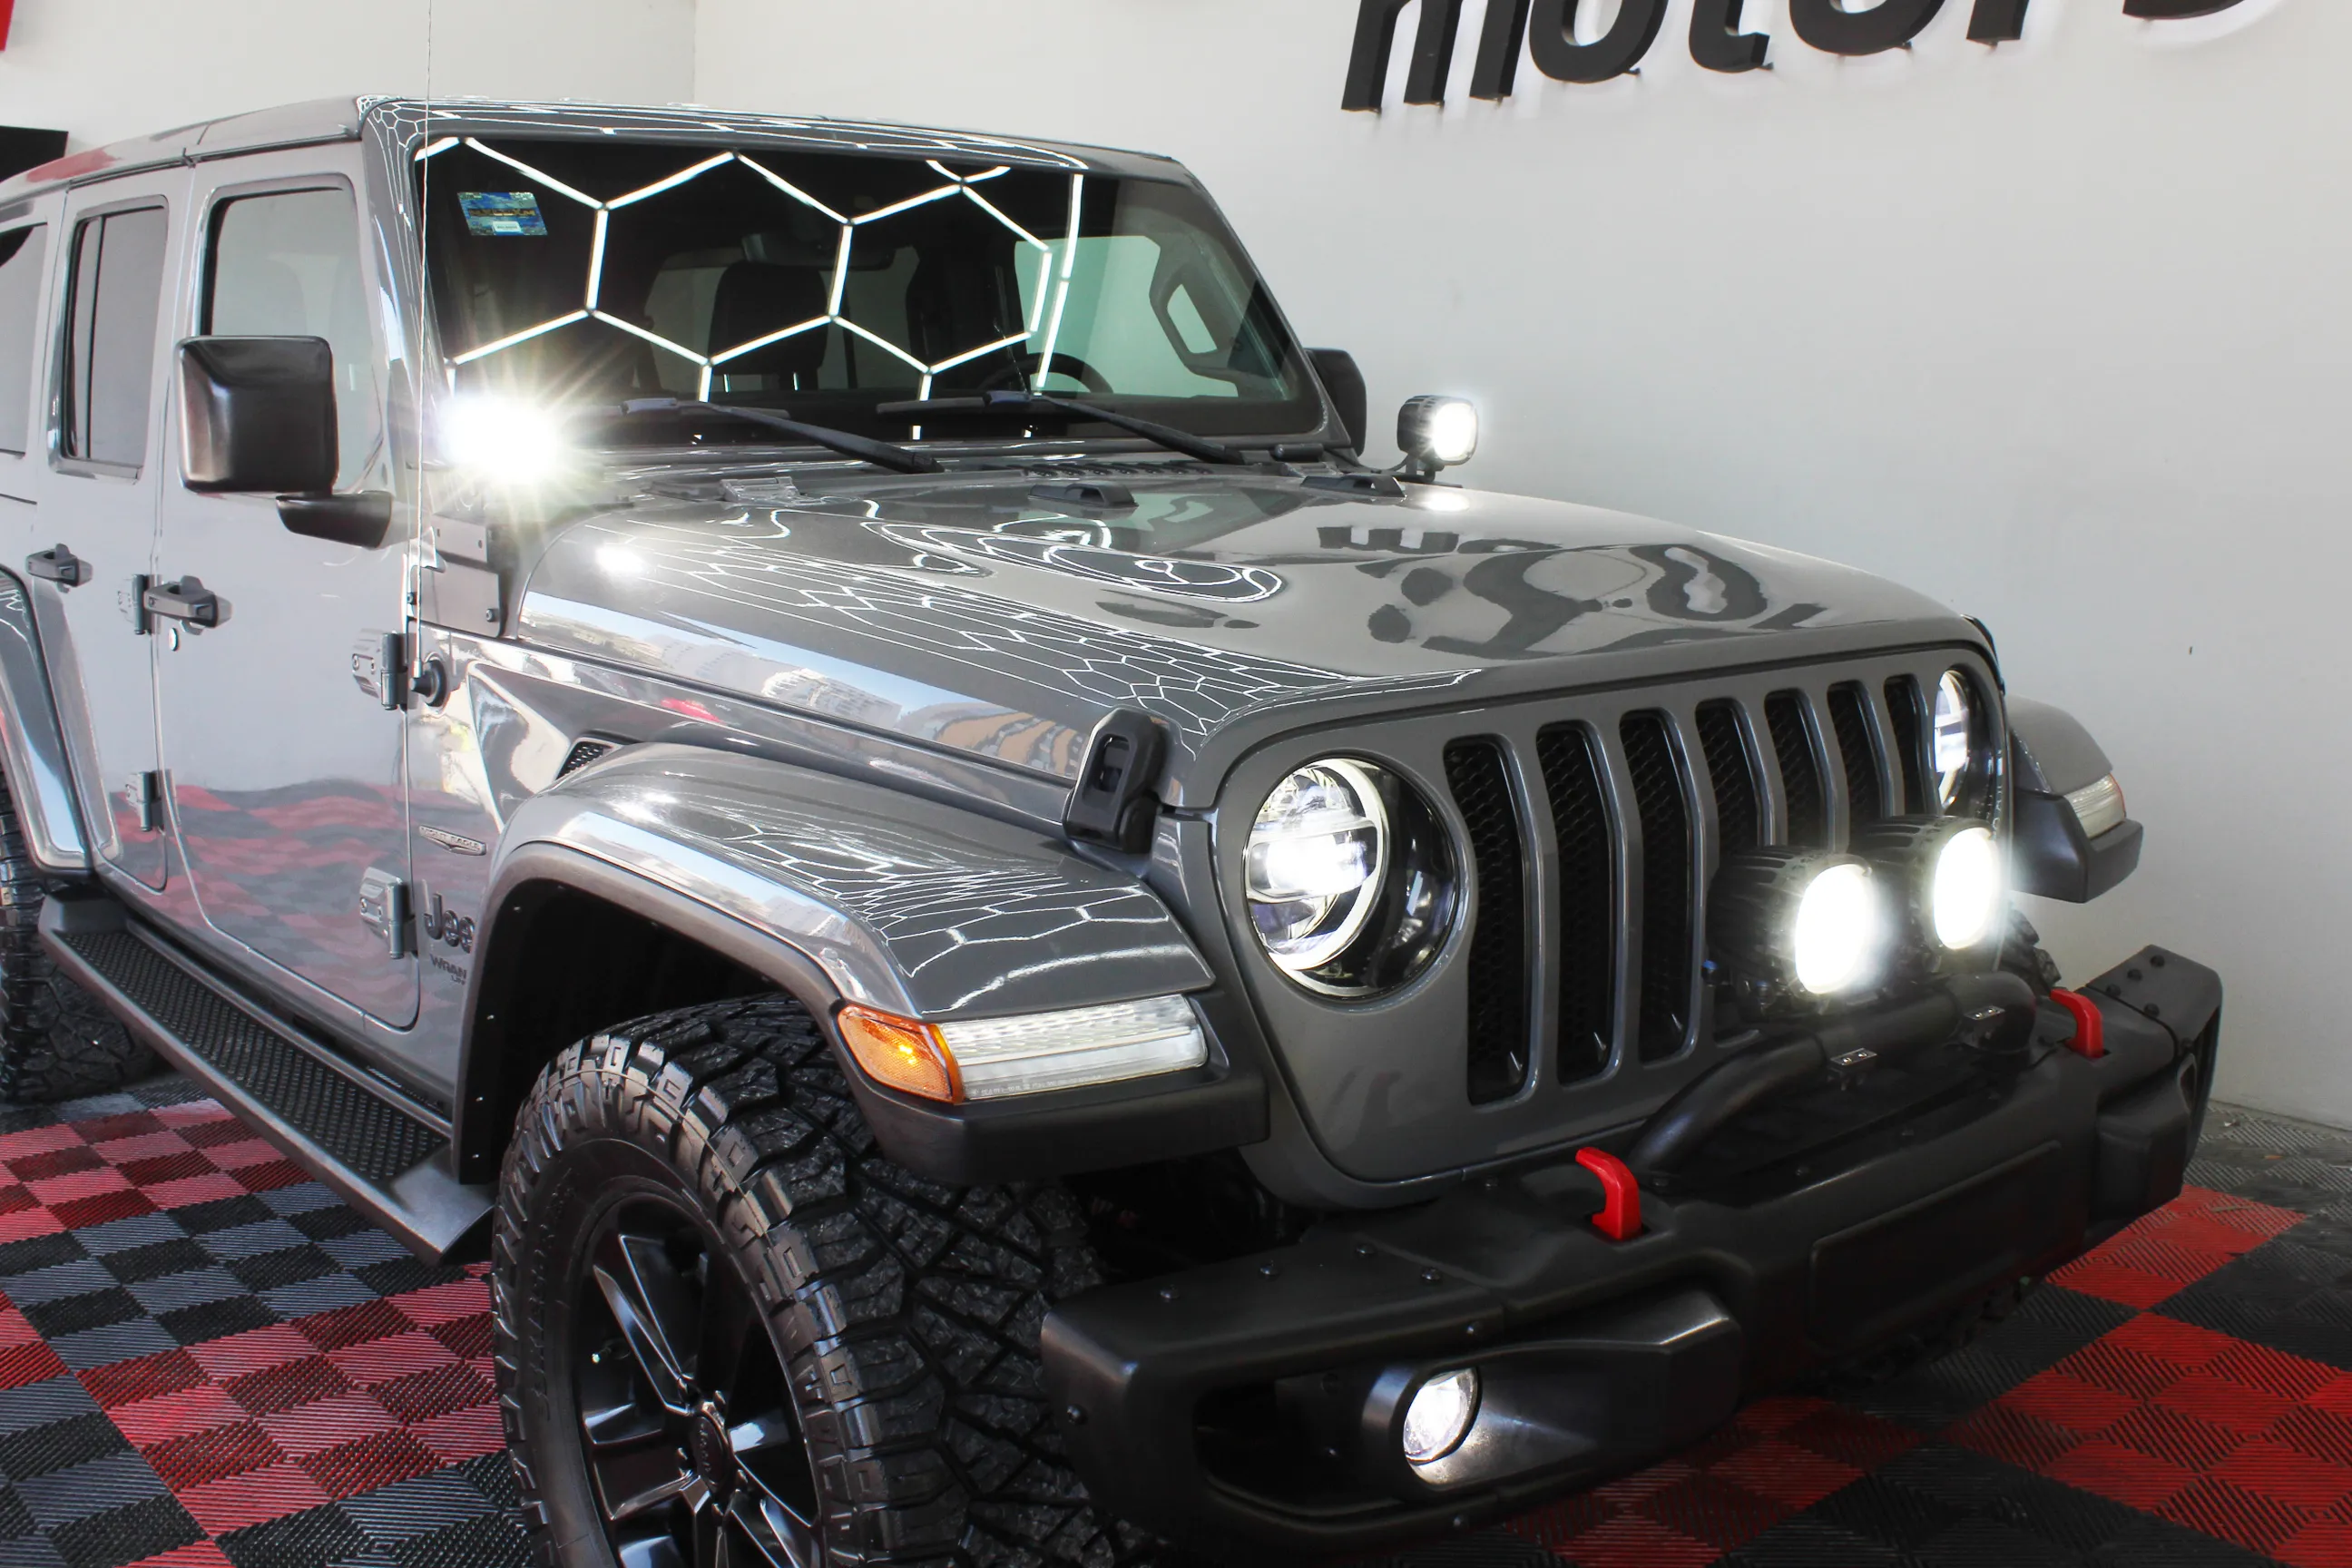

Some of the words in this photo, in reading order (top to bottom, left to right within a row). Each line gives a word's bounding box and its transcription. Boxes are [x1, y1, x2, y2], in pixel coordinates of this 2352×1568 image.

[1340, 0, 2245, 113] mot
[424, 892, 475, 953] Jee
[430, 954, 467, 979] WRAN
